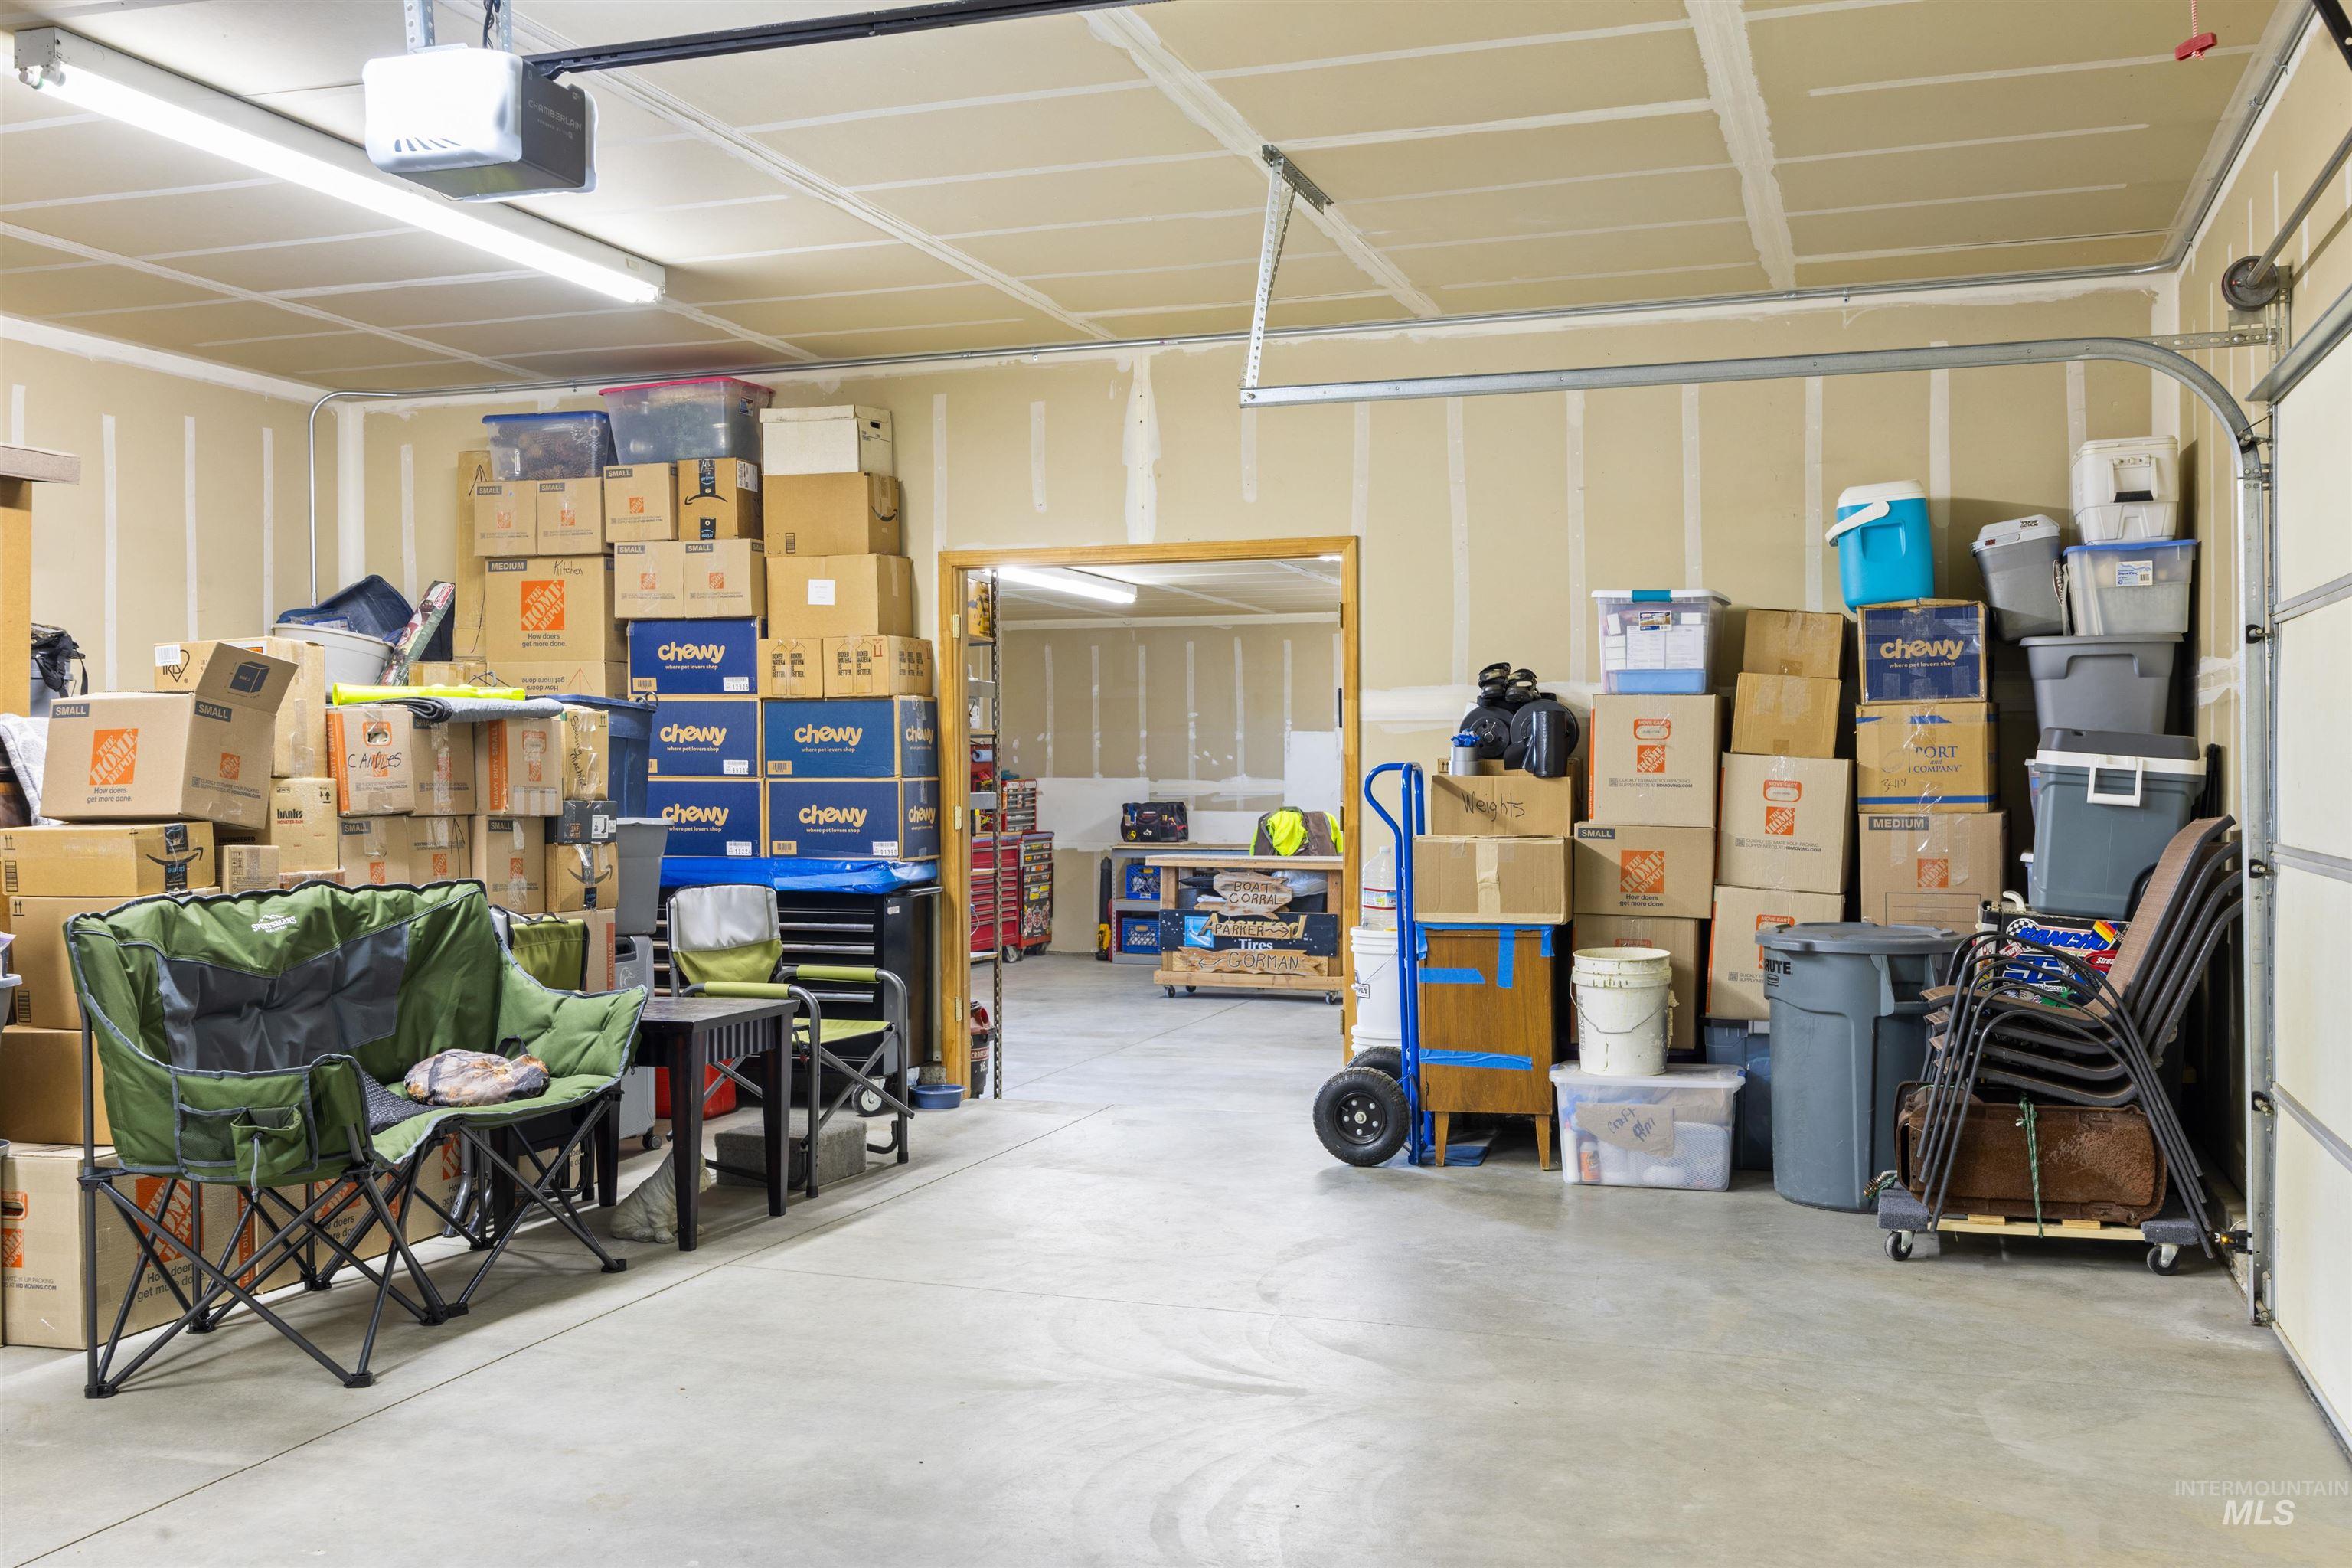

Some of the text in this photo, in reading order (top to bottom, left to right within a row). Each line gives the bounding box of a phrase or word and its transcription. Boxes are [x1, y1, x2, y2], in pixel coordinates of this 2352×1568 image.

[528, 99, 582, 132] CHAMBERLAIN
[491, 562, 524, 570] MEDIUM
[554, 560, 583, 576] Kitchen
[521, 580, 564, 630] HOME
[525, 586, 544, 606] THE
[537, 598, 564, 630] DEPOT
[658, 641, 725, 664] chewy
[1880, 638, 1964, 660] chewy
[55, 706, 86, 716] SMALL
[198, 704, 228, 719] SMALL
[570, 715, 583, 756] Sewing
[660, 723, 727, 746] chewy
[794, 724, 863, 746] chewy
[906, 726, 933, 744] chewy
[96, 735, 116, 756] THE
[90, 729, 139, 785] HOME
[106, 749, 136, 784] DEPOT
[1637, 745, 1665, 773] HOME
[1914, 765, 1960, 773] COMPANY
[87, 795, 97, 804] get
[1462, 791, 1525, 822] Weights
[276, 808, 303, 819] banks
[662, 803, 729, 826] chewy
[799, 804, 867, 828] chewy
[908, 805, 936, 824] chewy
[1765, 807, 1795, 834] HOME
[1873, 818, 1924, 828] MEDIUM
[345, 822, 368, 832] SMALL
[490, 822, 511, 830] SMALL
[1581, 829, 1612, 838] SMALL
[1620, 851, 1664, 893] HOME
[1625, 854, 1644, 871] THE
[1638, 866, 1664, 893] DEPOT
[1918, 858, 1949, 888] HOME
[1233, 880, 1272, 893] BOAT
[1229, 893, 1282, 905] CORRAL
[251, 916, 297, 932] SPORTSMANS
[1215, 923, 1264, 937] PARKER
[1238, 939, 1273, 950] Tires
[2017, 927, 2111, 951] RANCHO
[1229, 952, 1298, 969] GORMAN
[979, 1061, 985, 1072] 16
[1607, 1107, 1636, 1134] Craft
[333, 1215, 355, 1228] doers
[147, 1263, 193, 1284] Ho doer
[137, 1287, 153, 1302] get
